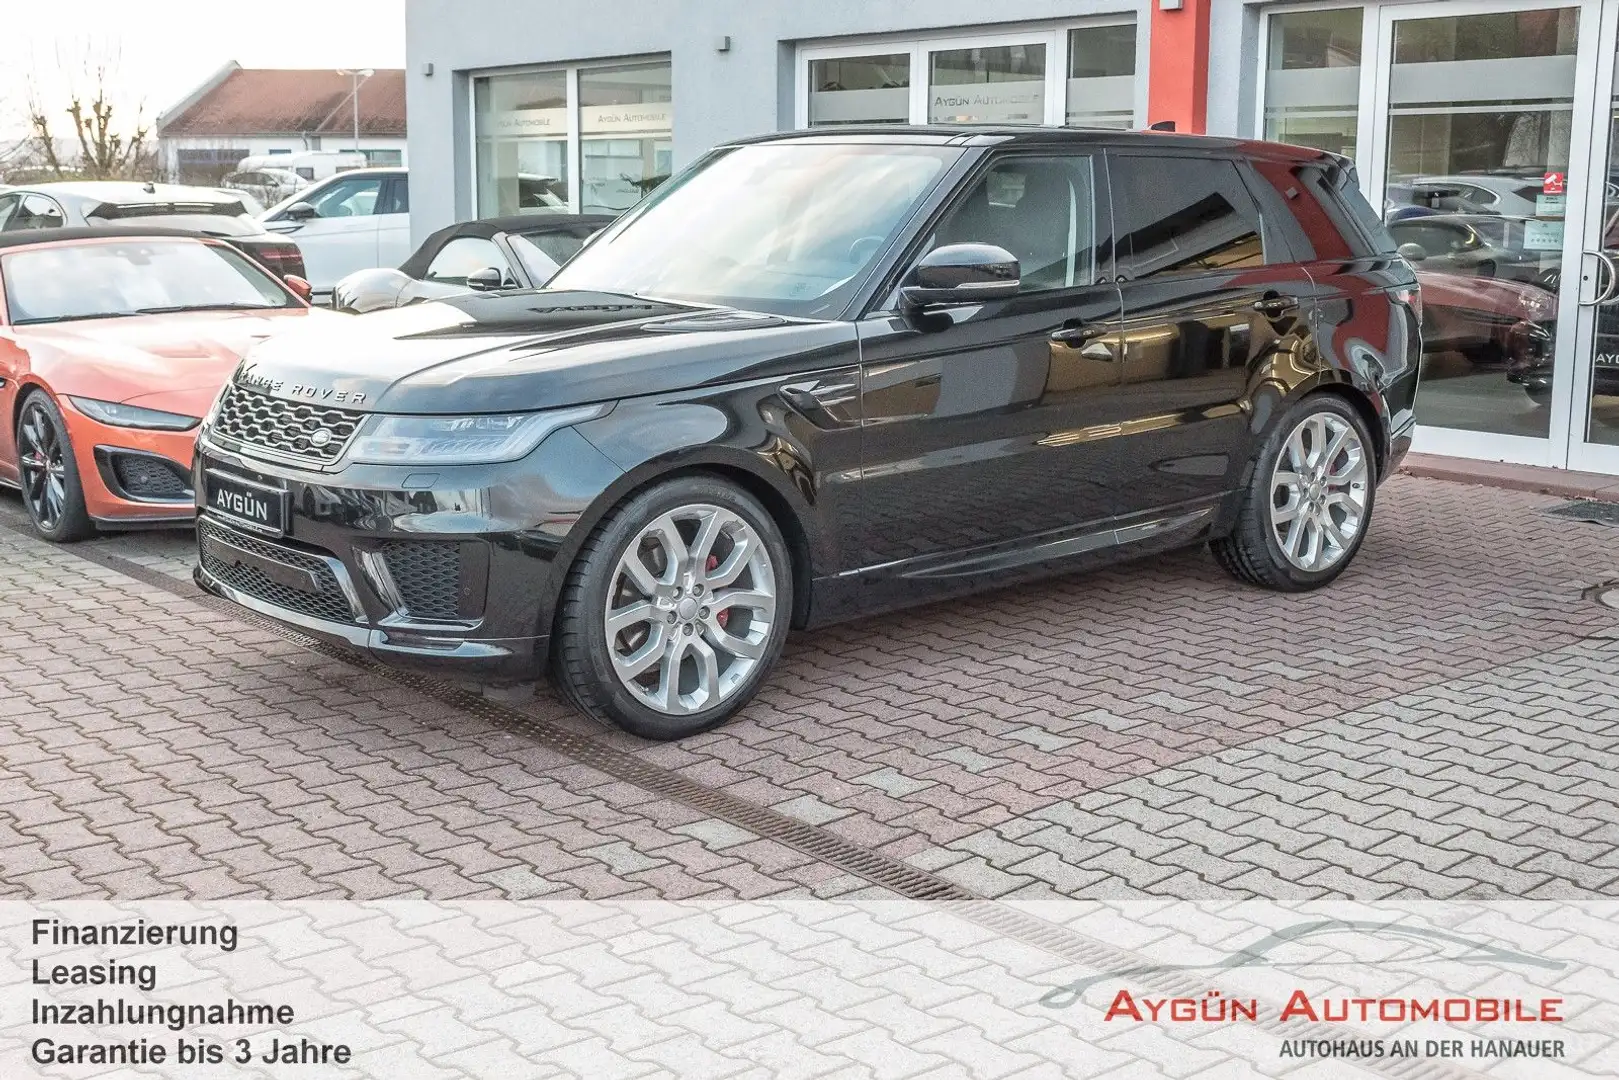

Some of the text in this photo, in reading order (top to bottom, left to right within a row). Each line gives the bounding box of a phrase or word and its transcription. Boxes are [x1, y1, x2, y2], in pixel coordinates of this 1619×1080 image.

[934, 95, 970, 107] AYGÜN
[239, 371, 367, 404] RANGE ROVER
[216, 488, 268, 521] AYGÜN
